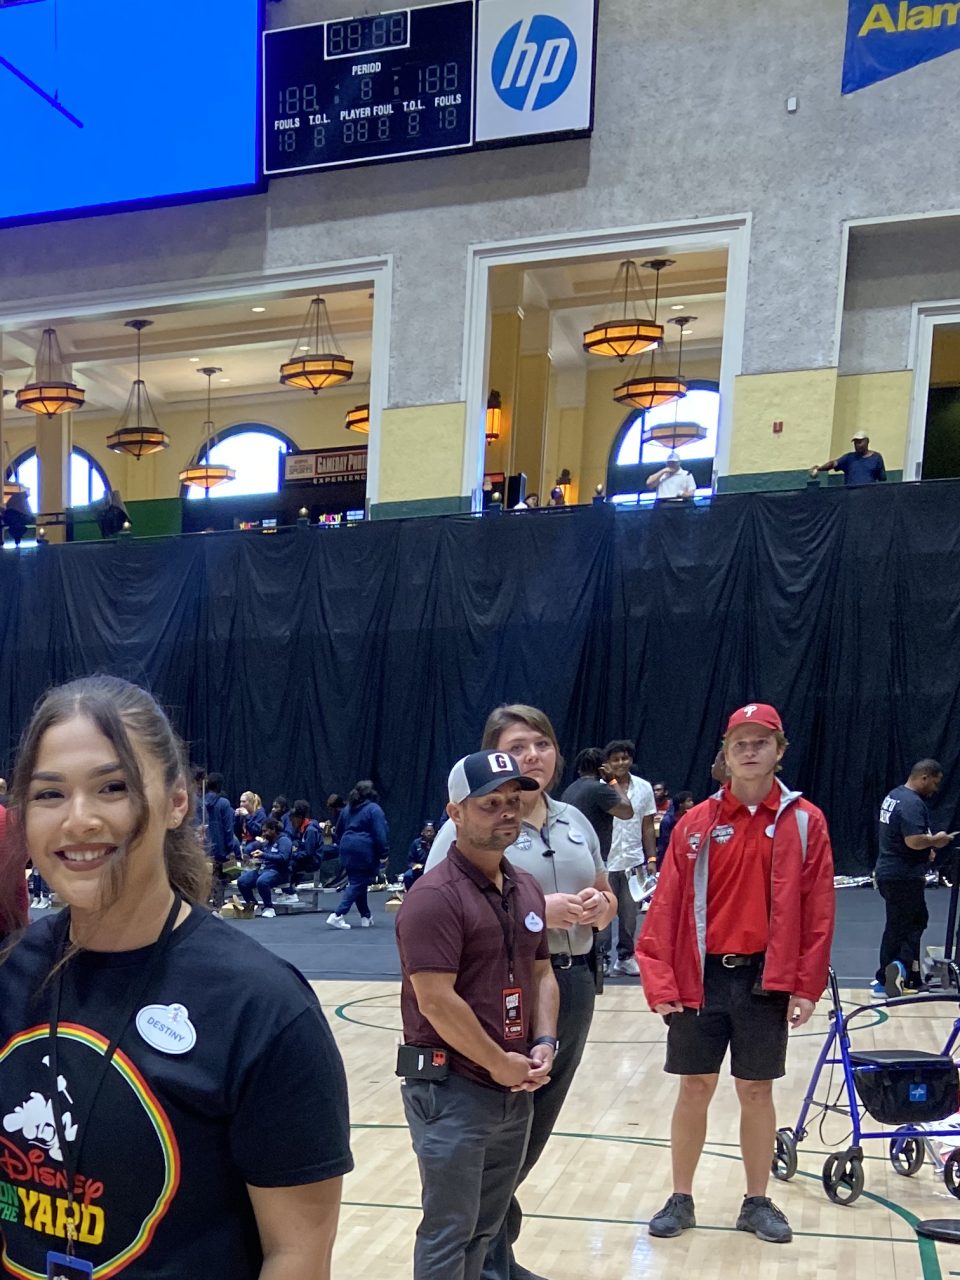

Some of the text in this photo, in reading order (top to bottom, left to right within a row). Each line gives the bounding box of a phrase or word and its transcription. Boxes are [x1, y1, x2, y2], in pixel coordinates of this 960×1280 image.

[352, 62, 382, 76] PERIOD
[500, 15, 570, 111] hp
[274, 94, 462, 130] FOULS T.O.L. PLAYER FOUL T.O.L. FOULS
[494, 754, 508, 769] G
[147, 1017, 185, 1042] DESTINY
[17, 1187, 105, 1245] YARD
